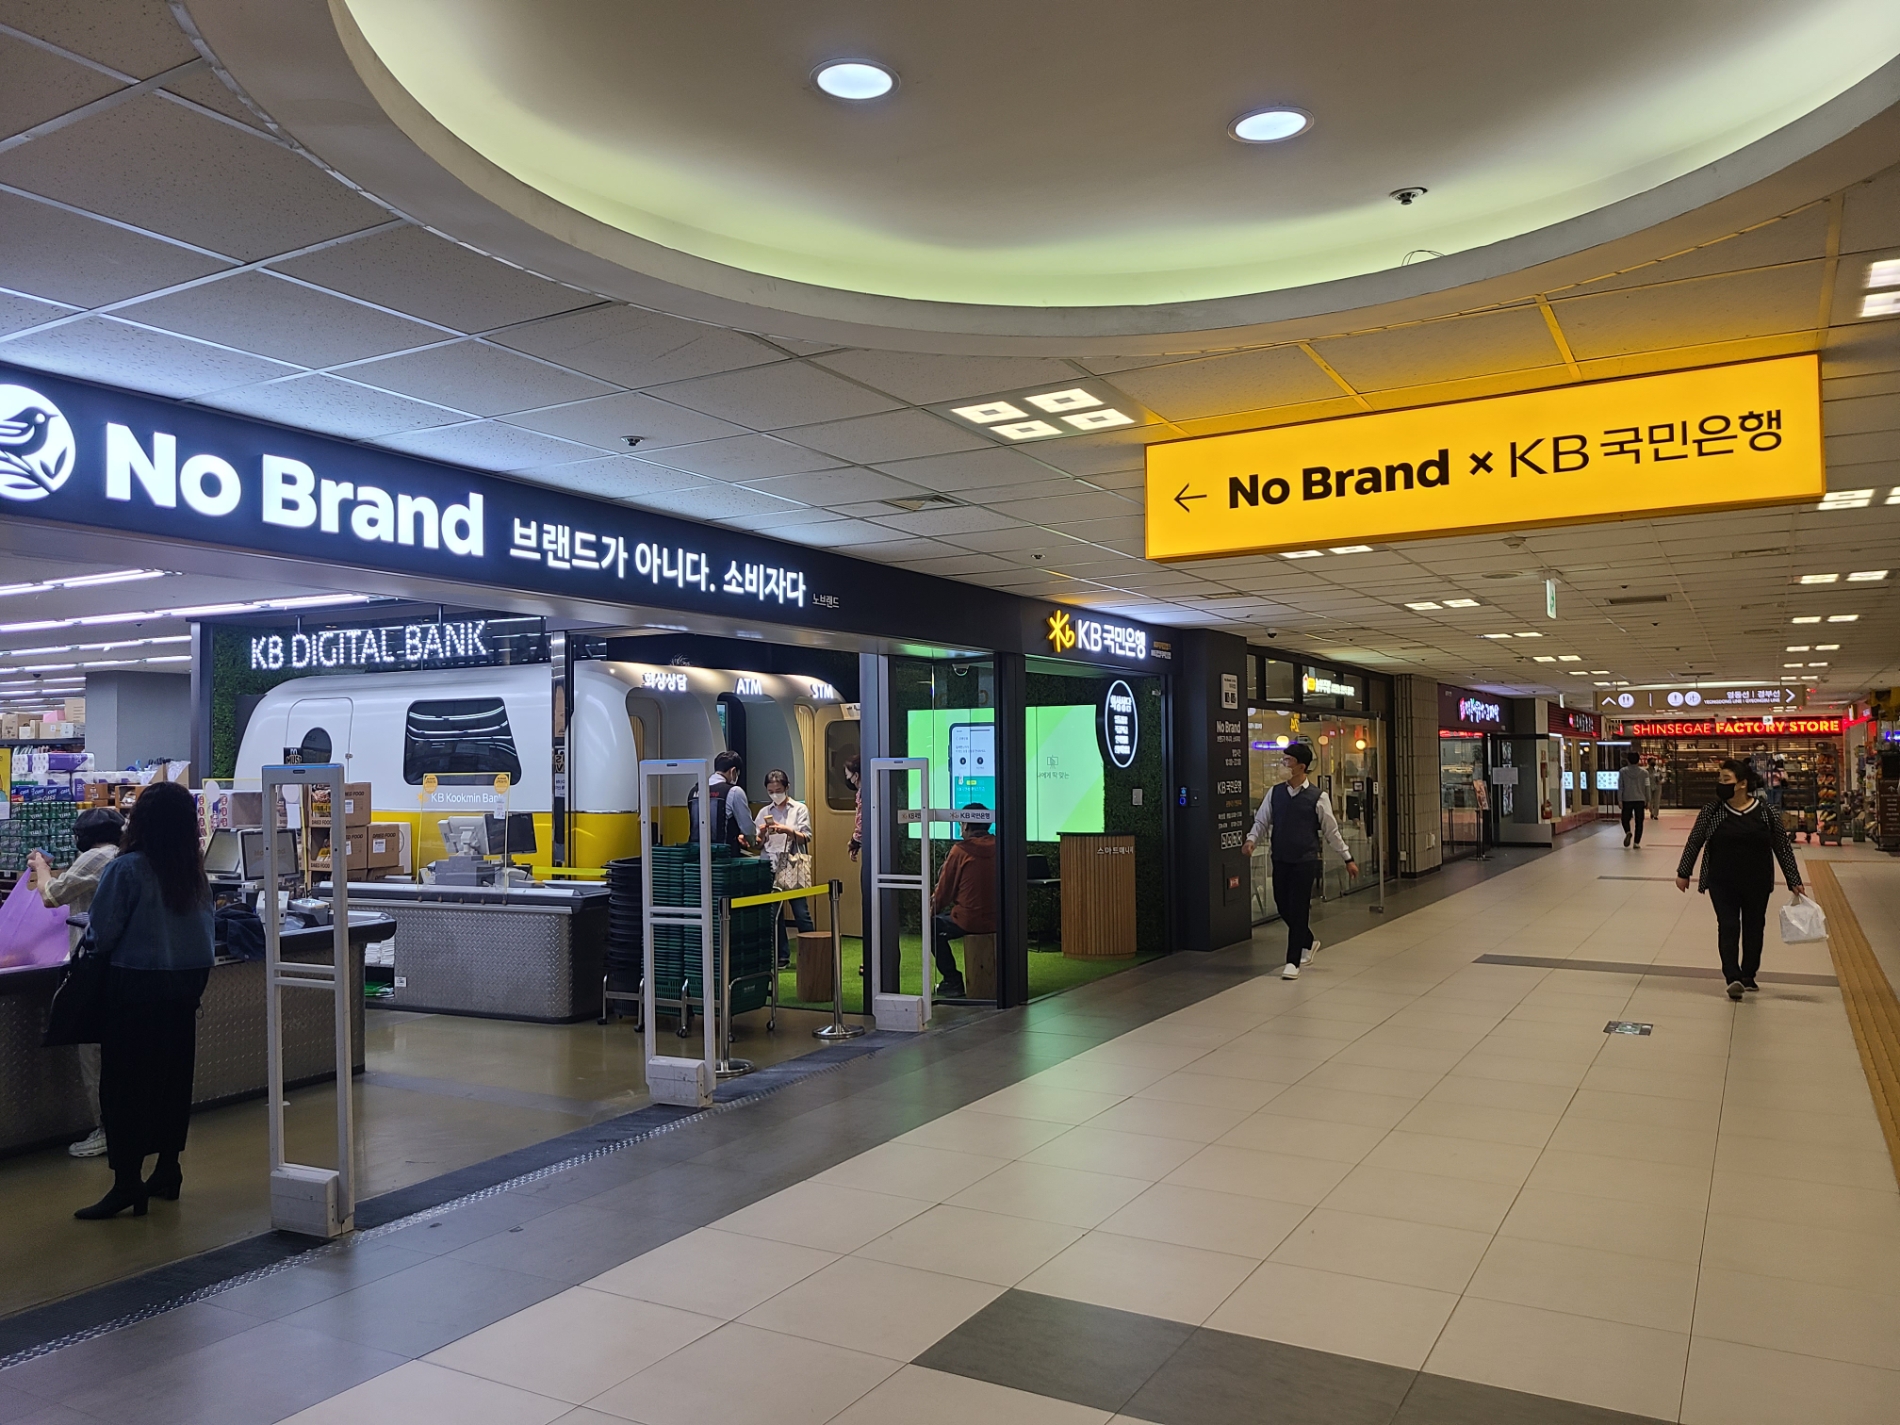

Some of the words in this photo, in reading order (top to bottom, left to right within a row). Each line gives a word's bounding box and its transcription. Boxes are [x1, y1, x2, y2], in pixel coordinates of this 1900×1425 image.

[1228, 475, 1290, 510] No
[1302, 448, 1450, 501] Brand
[106, 421, 241, 518] No
[261, 452, 485, 557] Brand
[509, 517, 629, 579] 브랜드가
[635, 542, 716, 592] 아니다.
[722, 566, 808, 608] 소비자다
[812, 592, 840, 610] 노브랜드
[250, 634, 285, 671] KB
[291, 628, 394, 668] DIGITAL
[404, 619, 488, 662] BANK
[642, 672, 688, 692] 화상상담
[735, 677, 762, 696] ATM
[811, 683, 834, 700] STM
[1216, 720, 1225, 733] No
[1225, 720, 1241, 734] Brand
[1633, 722, 1711, 736] SHINSEGAE
[1715, 720, 1786, 734] FACTORY
[1789, 719, 1840, 733] STORE
[431, 792, 445, 803] KB
[445, 792, 481, 803] Kookmin
